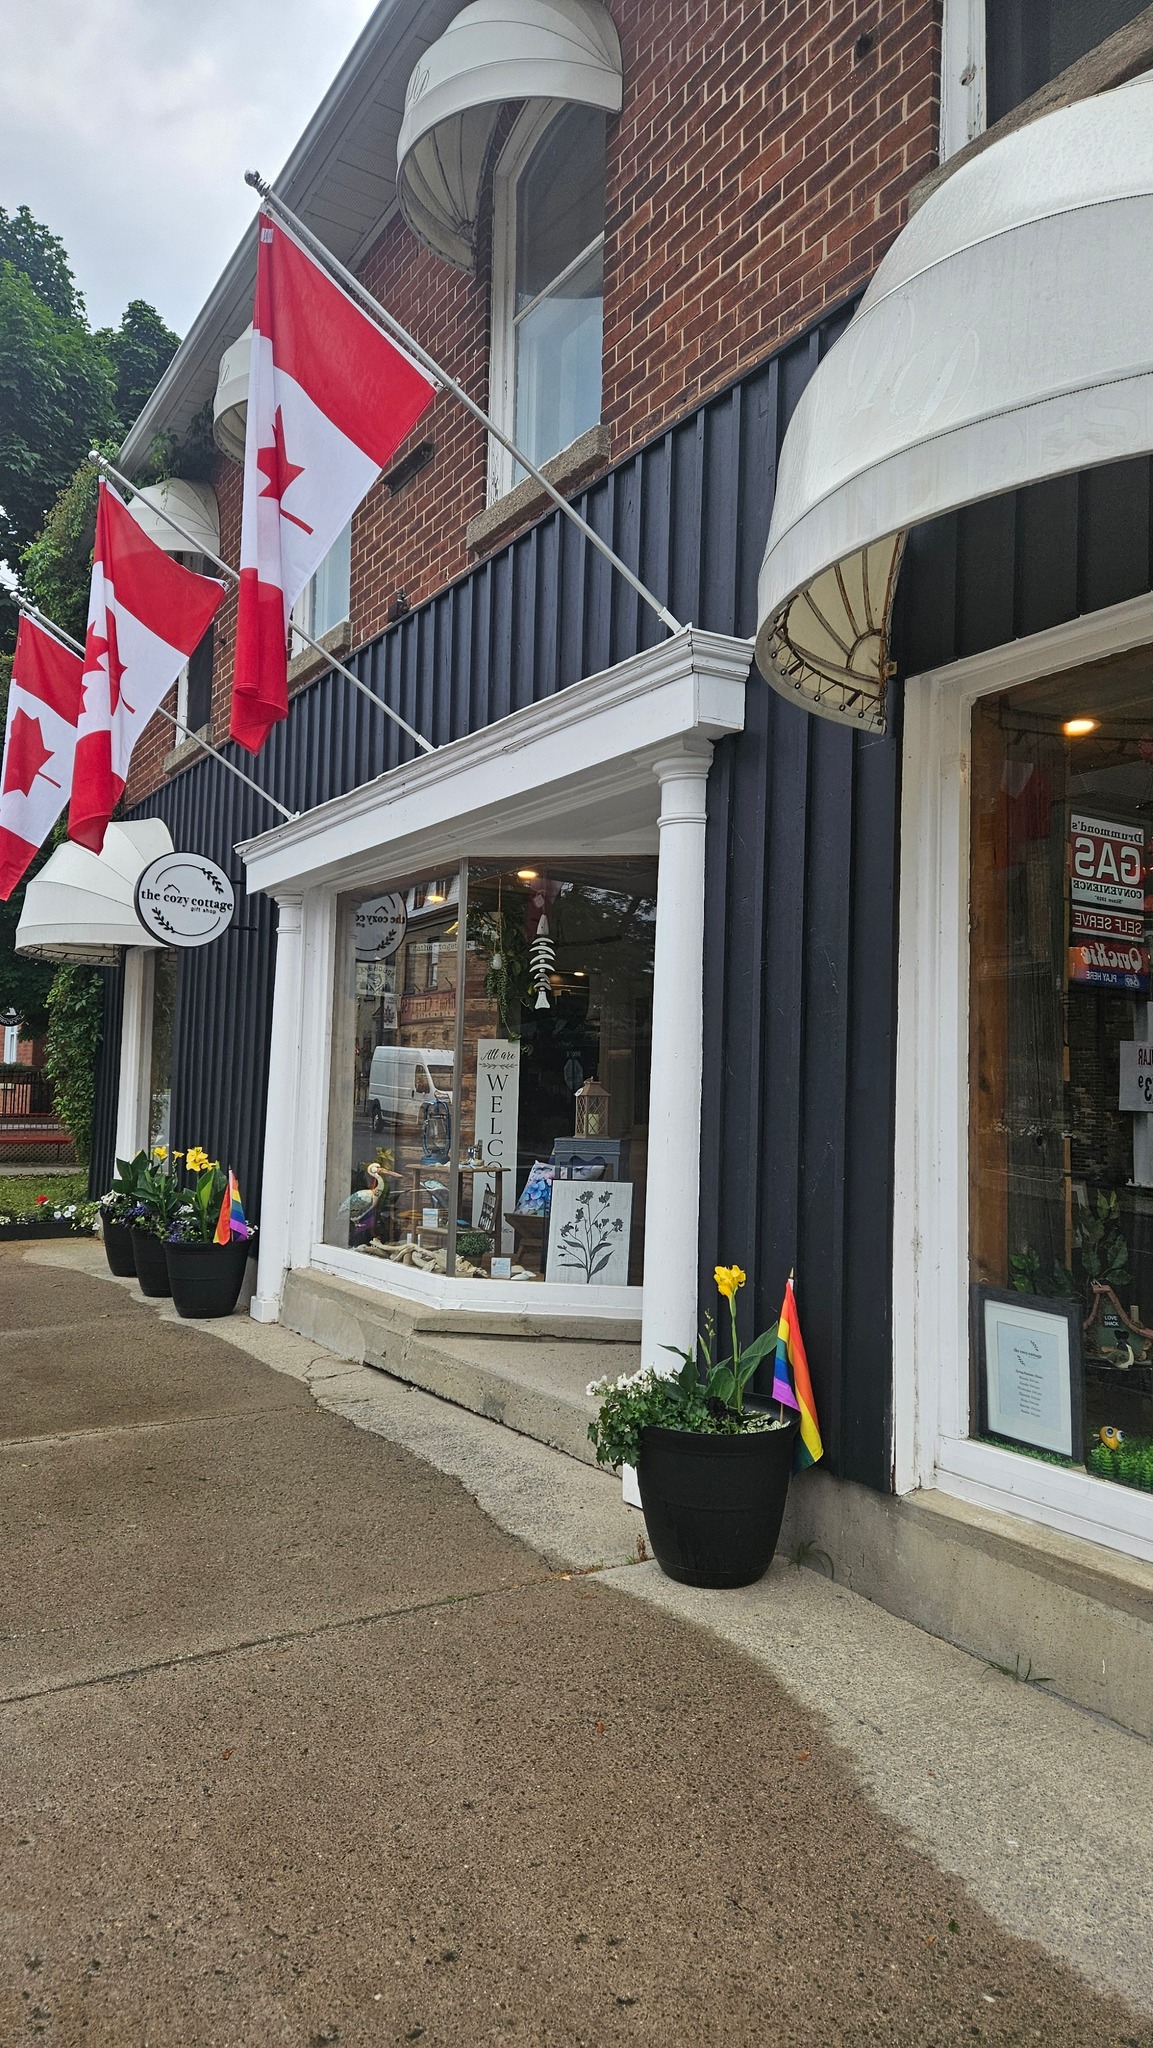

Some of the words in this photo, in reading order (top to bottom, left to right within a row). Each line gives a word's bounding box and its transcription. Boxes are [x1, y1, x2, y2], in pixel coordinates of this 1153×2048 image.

[141, 888, 160, 900] the
[163, 893, 189, 907] cozy
[191, 898, 233, 913] cottage
[480, 1047, 499, 1061] All
[500, 1051, 516, 1061] are
